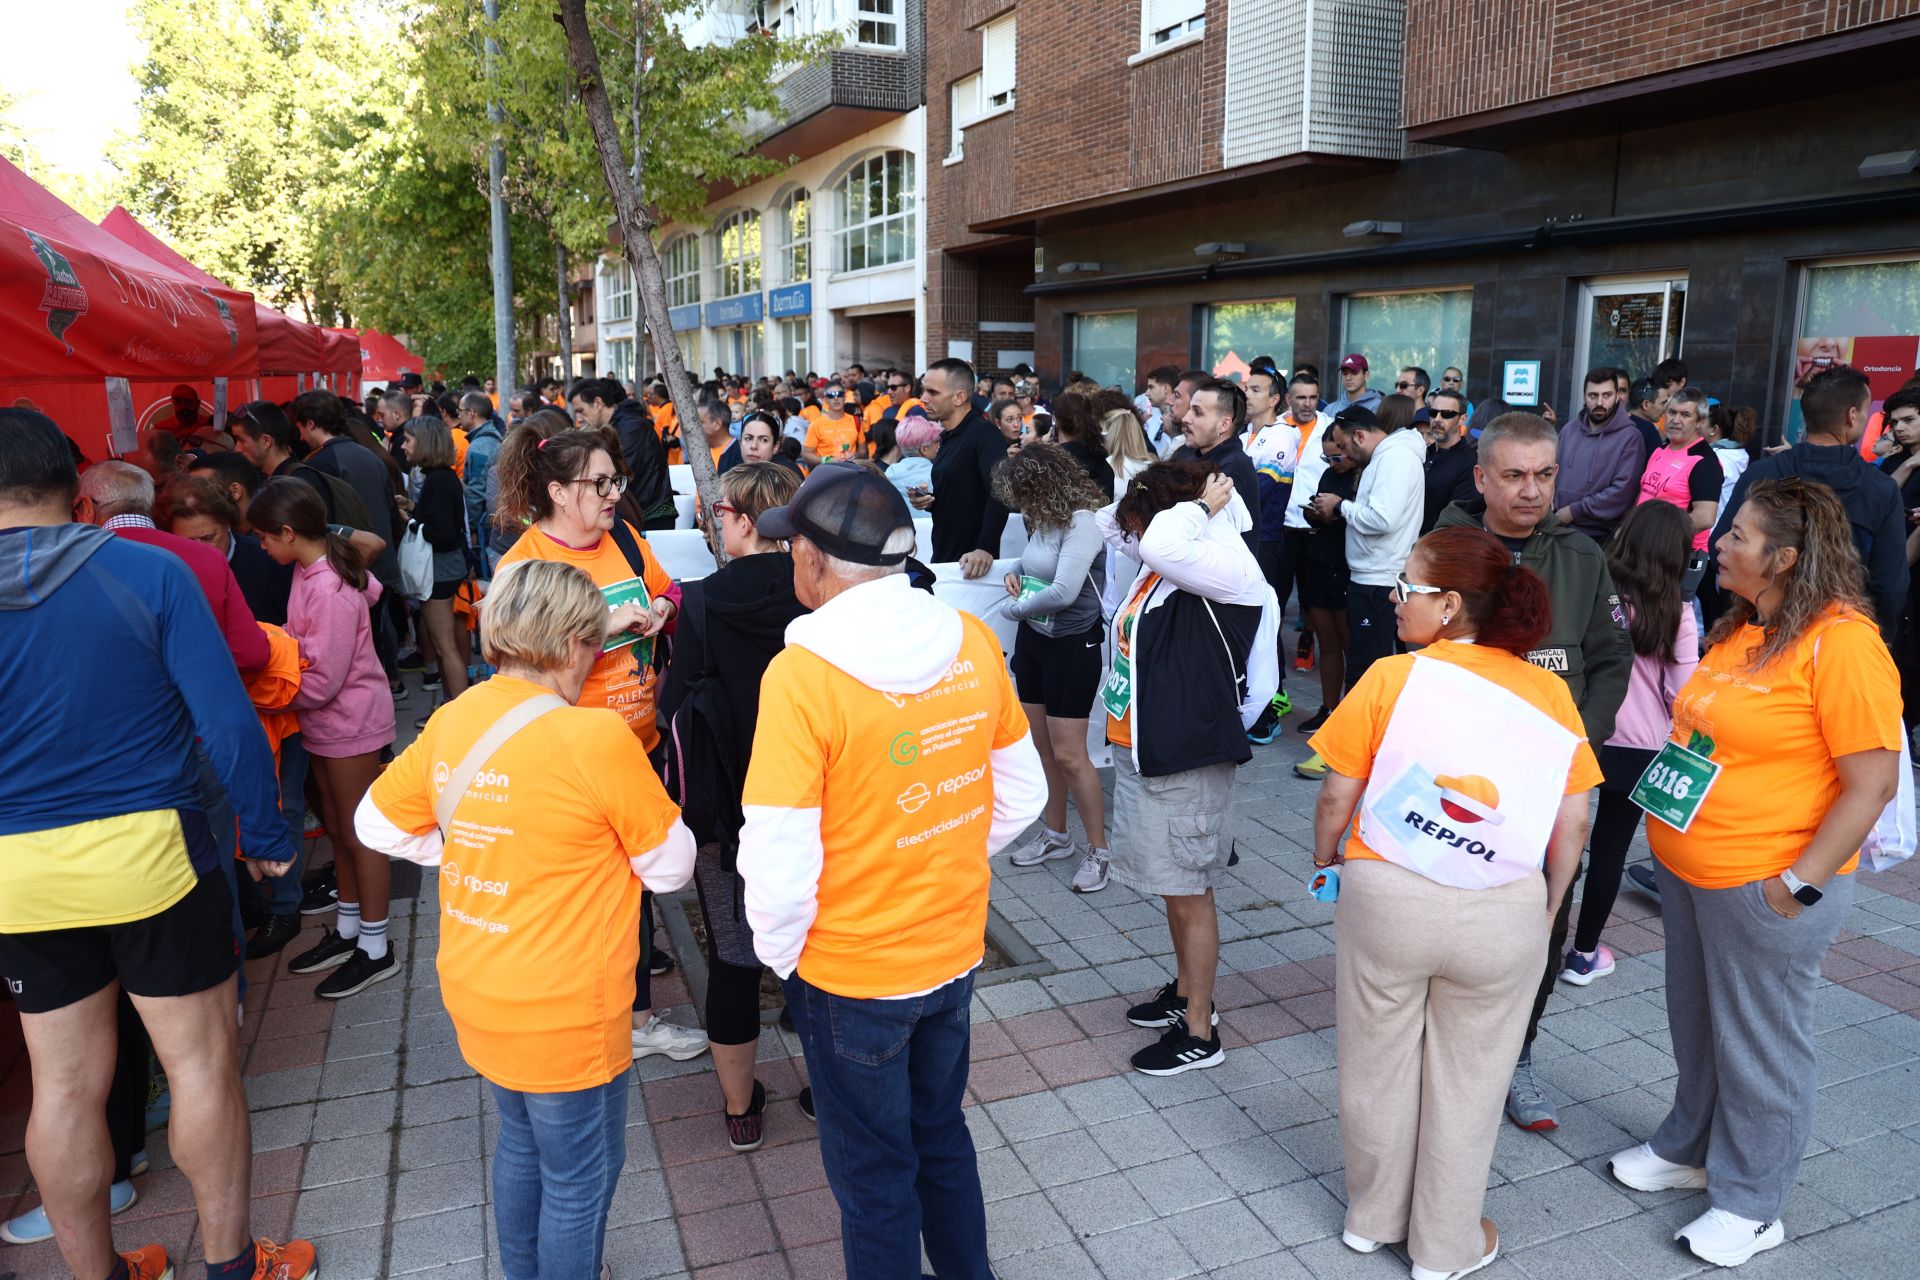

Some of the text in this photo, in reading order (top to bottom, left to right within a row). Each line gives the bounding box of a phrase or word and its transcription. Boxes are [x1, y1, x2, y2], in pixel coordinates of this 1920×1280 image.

[607, 686, 650, 706] PALEN
[915, 677, 980, 702] comercial
[465, 789, 509, 803] mercial
[936, 764, 987, 797] repsol
[1647, 762, 1694, 800] 6116
[896, 809, 963, 849] Electricidad
[970, 804, 985, 821] gas
[1404, 810, 1497, 863] REPSOL
